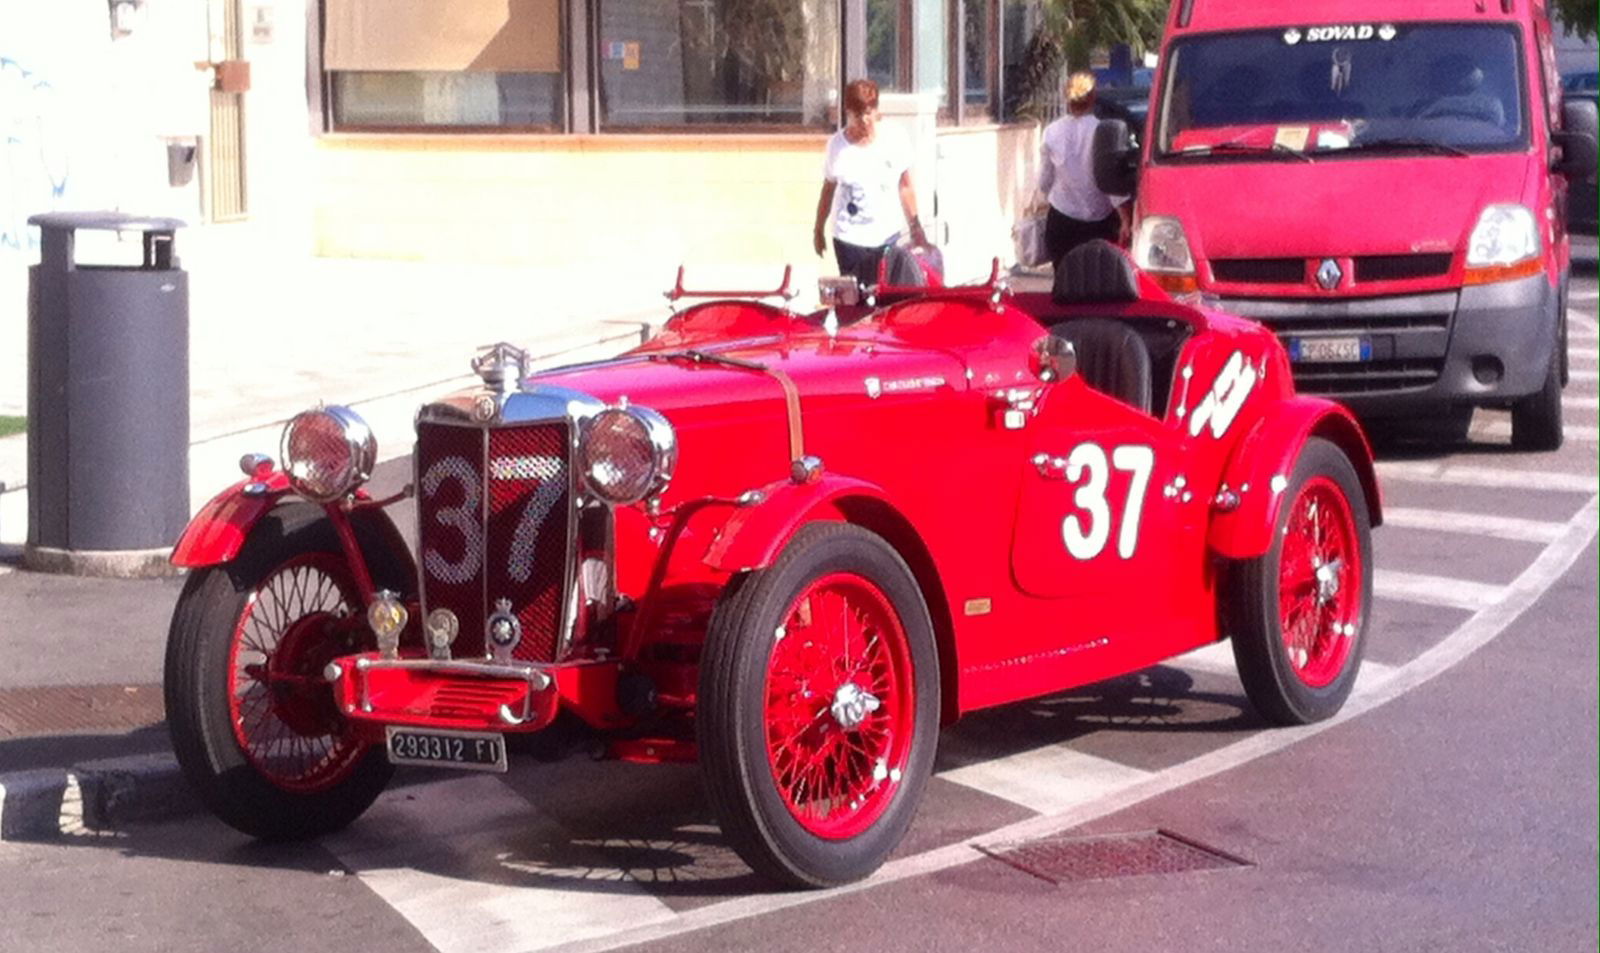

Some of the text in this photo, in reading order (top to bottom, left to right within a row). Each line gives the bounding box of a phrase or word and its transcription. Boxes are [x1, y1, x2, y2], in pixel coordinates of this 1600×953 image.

[1306, 25, 1374, 42] SOVAD
[421, 455, 567, 584] 37
[1062, 441, 1154, 560] 37
[395, 735, 496, 762] 293312 FI
